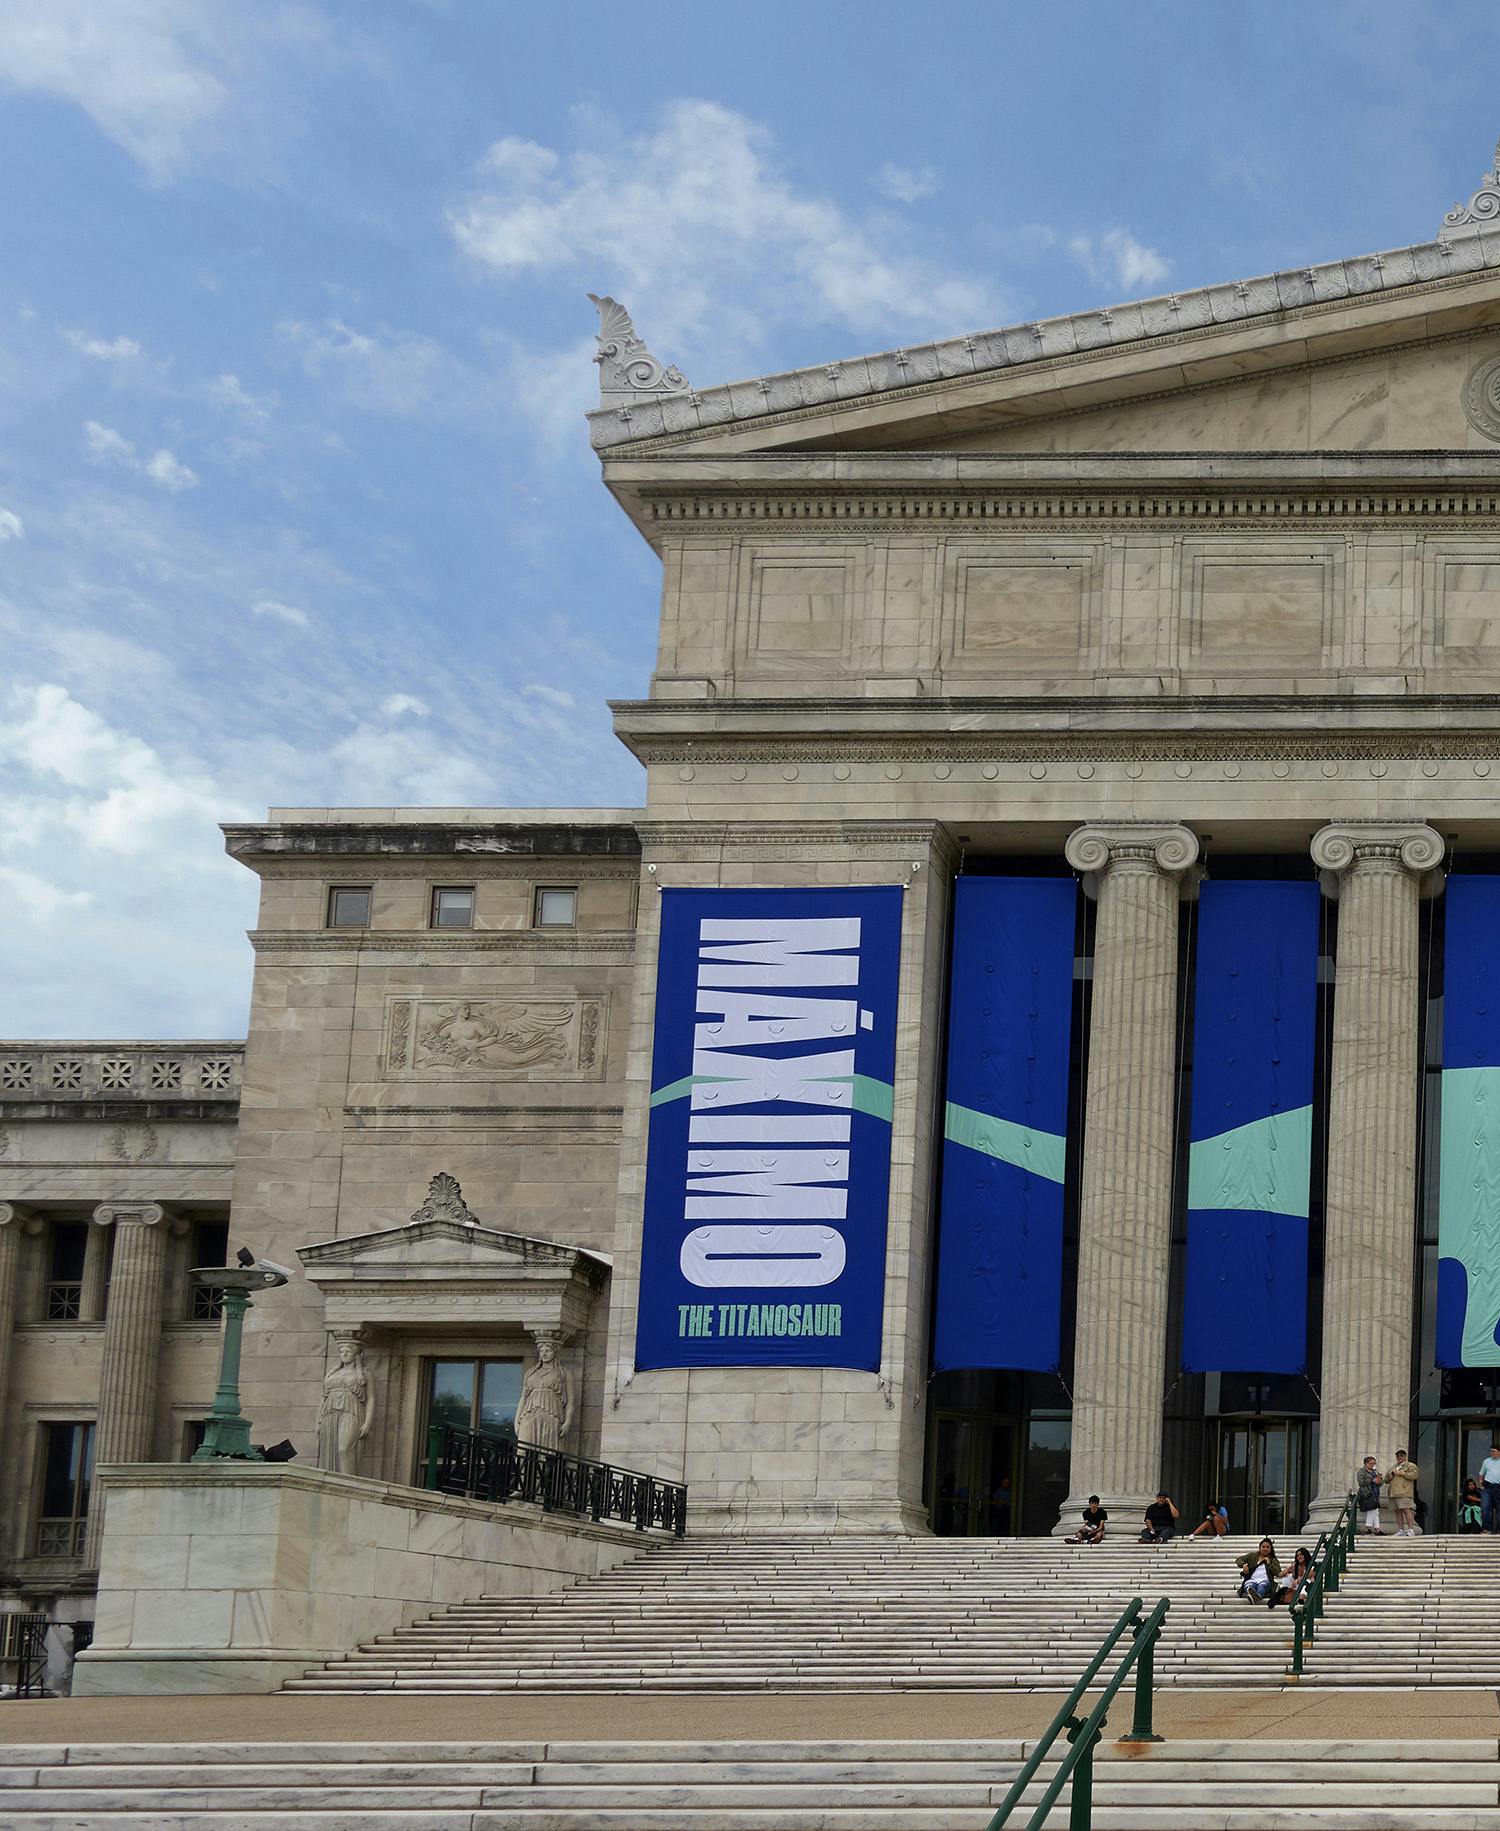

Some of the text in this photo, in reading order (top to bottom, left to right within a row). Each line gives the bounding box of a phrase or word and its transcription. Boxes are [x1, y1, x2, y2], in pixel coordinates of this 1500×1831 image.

[680, 917, 874, 1288] MÁXIMO
[678, 1303, 842, 1337] THE TITANOSAUR
